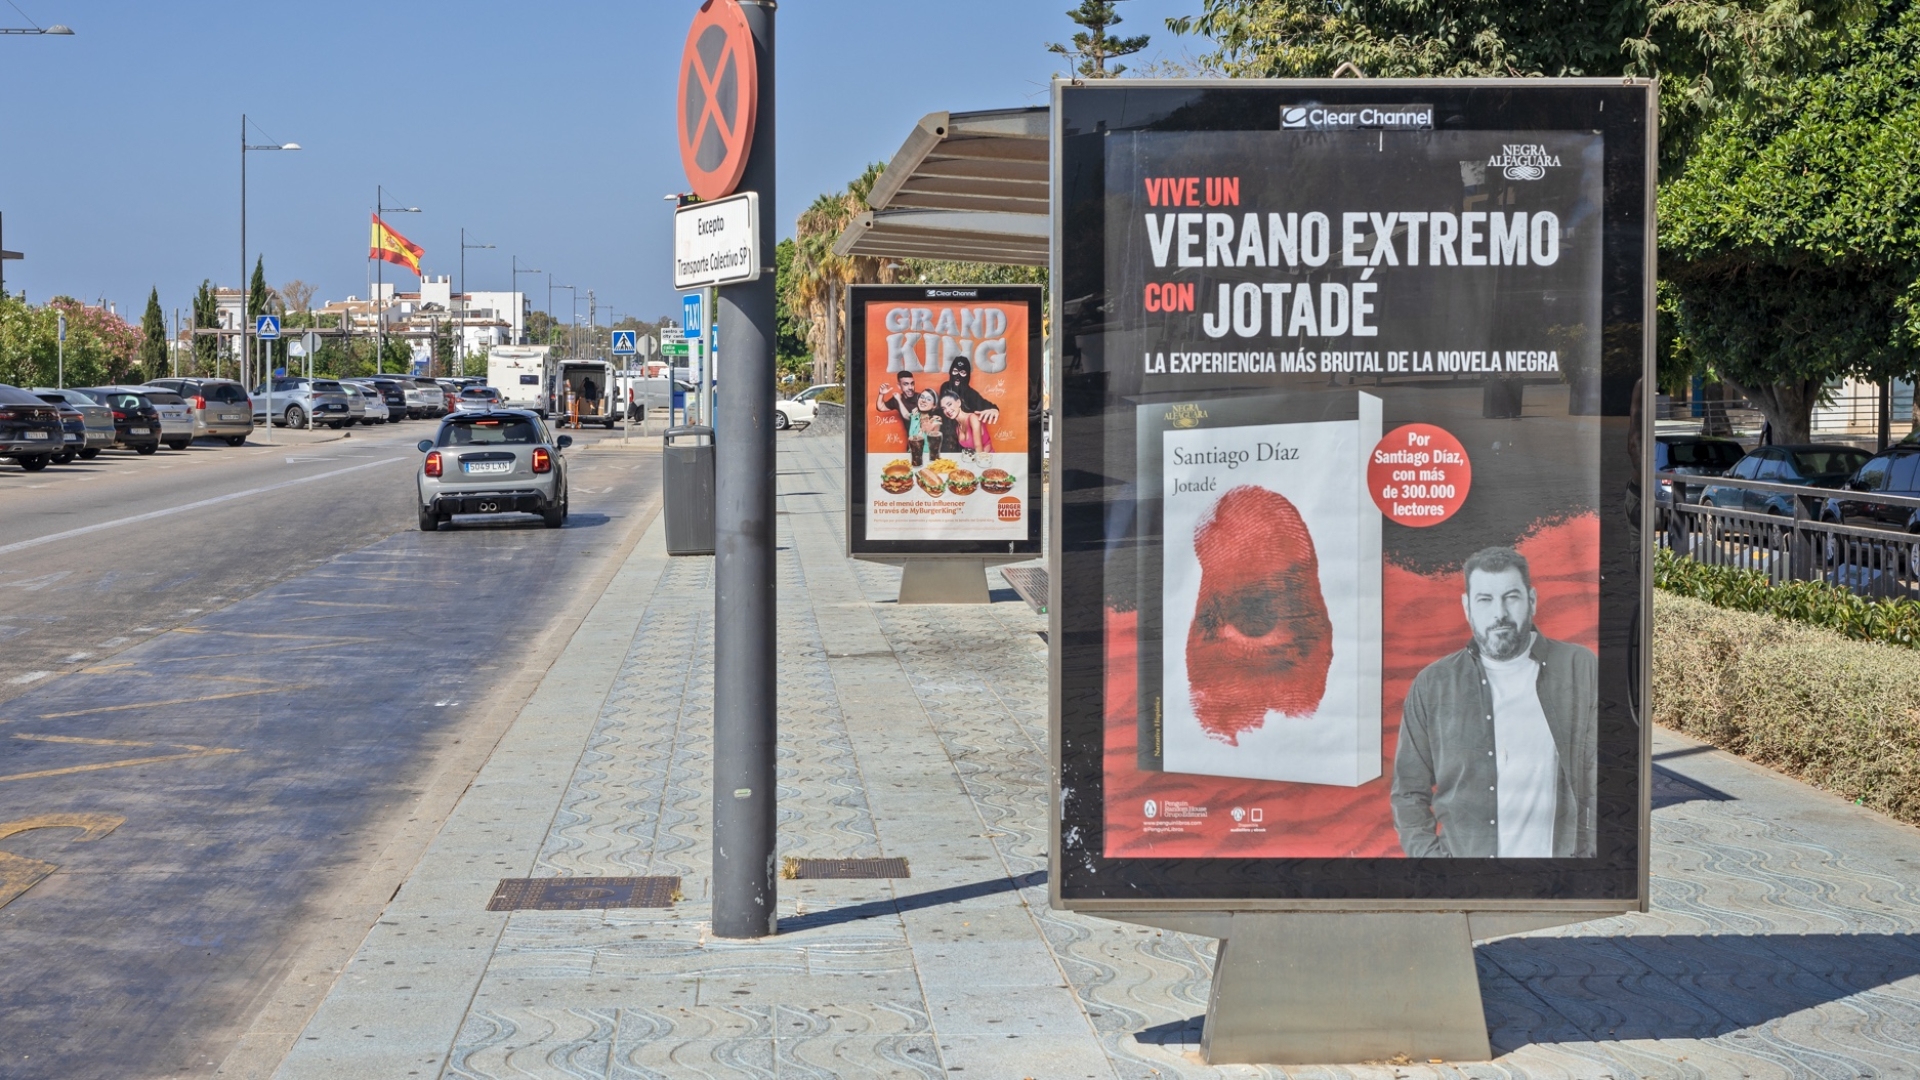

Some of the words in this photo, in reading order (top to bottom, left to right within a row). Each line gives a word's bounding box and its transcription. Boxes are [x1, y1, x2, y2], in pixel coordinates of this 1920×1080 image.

[1309, 109, 1356, 125] Clear
[1359, 109, 1431, 125] Channel
[1502, 144, 1547, 156] NEGRA
[1487, 155, 1562, 167] ALFAGUARA
[1145, 177, 1200, 206] VIVE
[1205, 176, 1240, 206] UN
[698, 215, 724, 237] Excepto
[1145, 212, 1331, 267] VERANO
[1342, 211, 1560, 267] EXTREMO
[677, 256, 709, 278] Transporte
[710, 249, 739, 271] Colectivo
[739, 246, 747, 266] SP
[1144, 282, 1194, 313] CON
[1203, 268, 1378, 338] JOTADÉ
[684, 303, 700, 331] TAXI
[885, 307, 1007, 339] GRAND
[886, 333, 1007, 374] KING
[1145, 352, 1166, 373] LA
[1170, 351, 1277, 373] EXPERIENCIA
[1280, 347, 1317, 373] MÁS
[1320, 351, 1384, 373] BRUTAL
[1387, 351, 1409, 372] DE
[1412, 351, 1433, 372] LA
[1437, 351, 1501, 372] NOVELA
[1505, 351, 1559, 372] NEGRA
[1172, 403, 1199, 413] NEGRA
[1408, 432, 1430, 446] Por
[1173, 446, 1250, 470] Santiago
[1256, 442, 1300, 462] Díaz
[1374, 449, 1430, 467] Santiago
[1433, 449, 1464, 467] Díaz,
[470, 462, 490, 470] 5049
[492, 462, 508, 470] LXN
[1392, 469, 1416, 481] con
[1419, 467, 1446, 481] más
[1172, 476, 1217, 496] Jotadé
[1382, 484, 1399, 499] de
[1401, 484, 1456, 499] 300.000
[998, 509, 1021, 517] KING
[1393, 501, 1445, 516] lectores
[1164, 800, 1189, 809] Penguin
